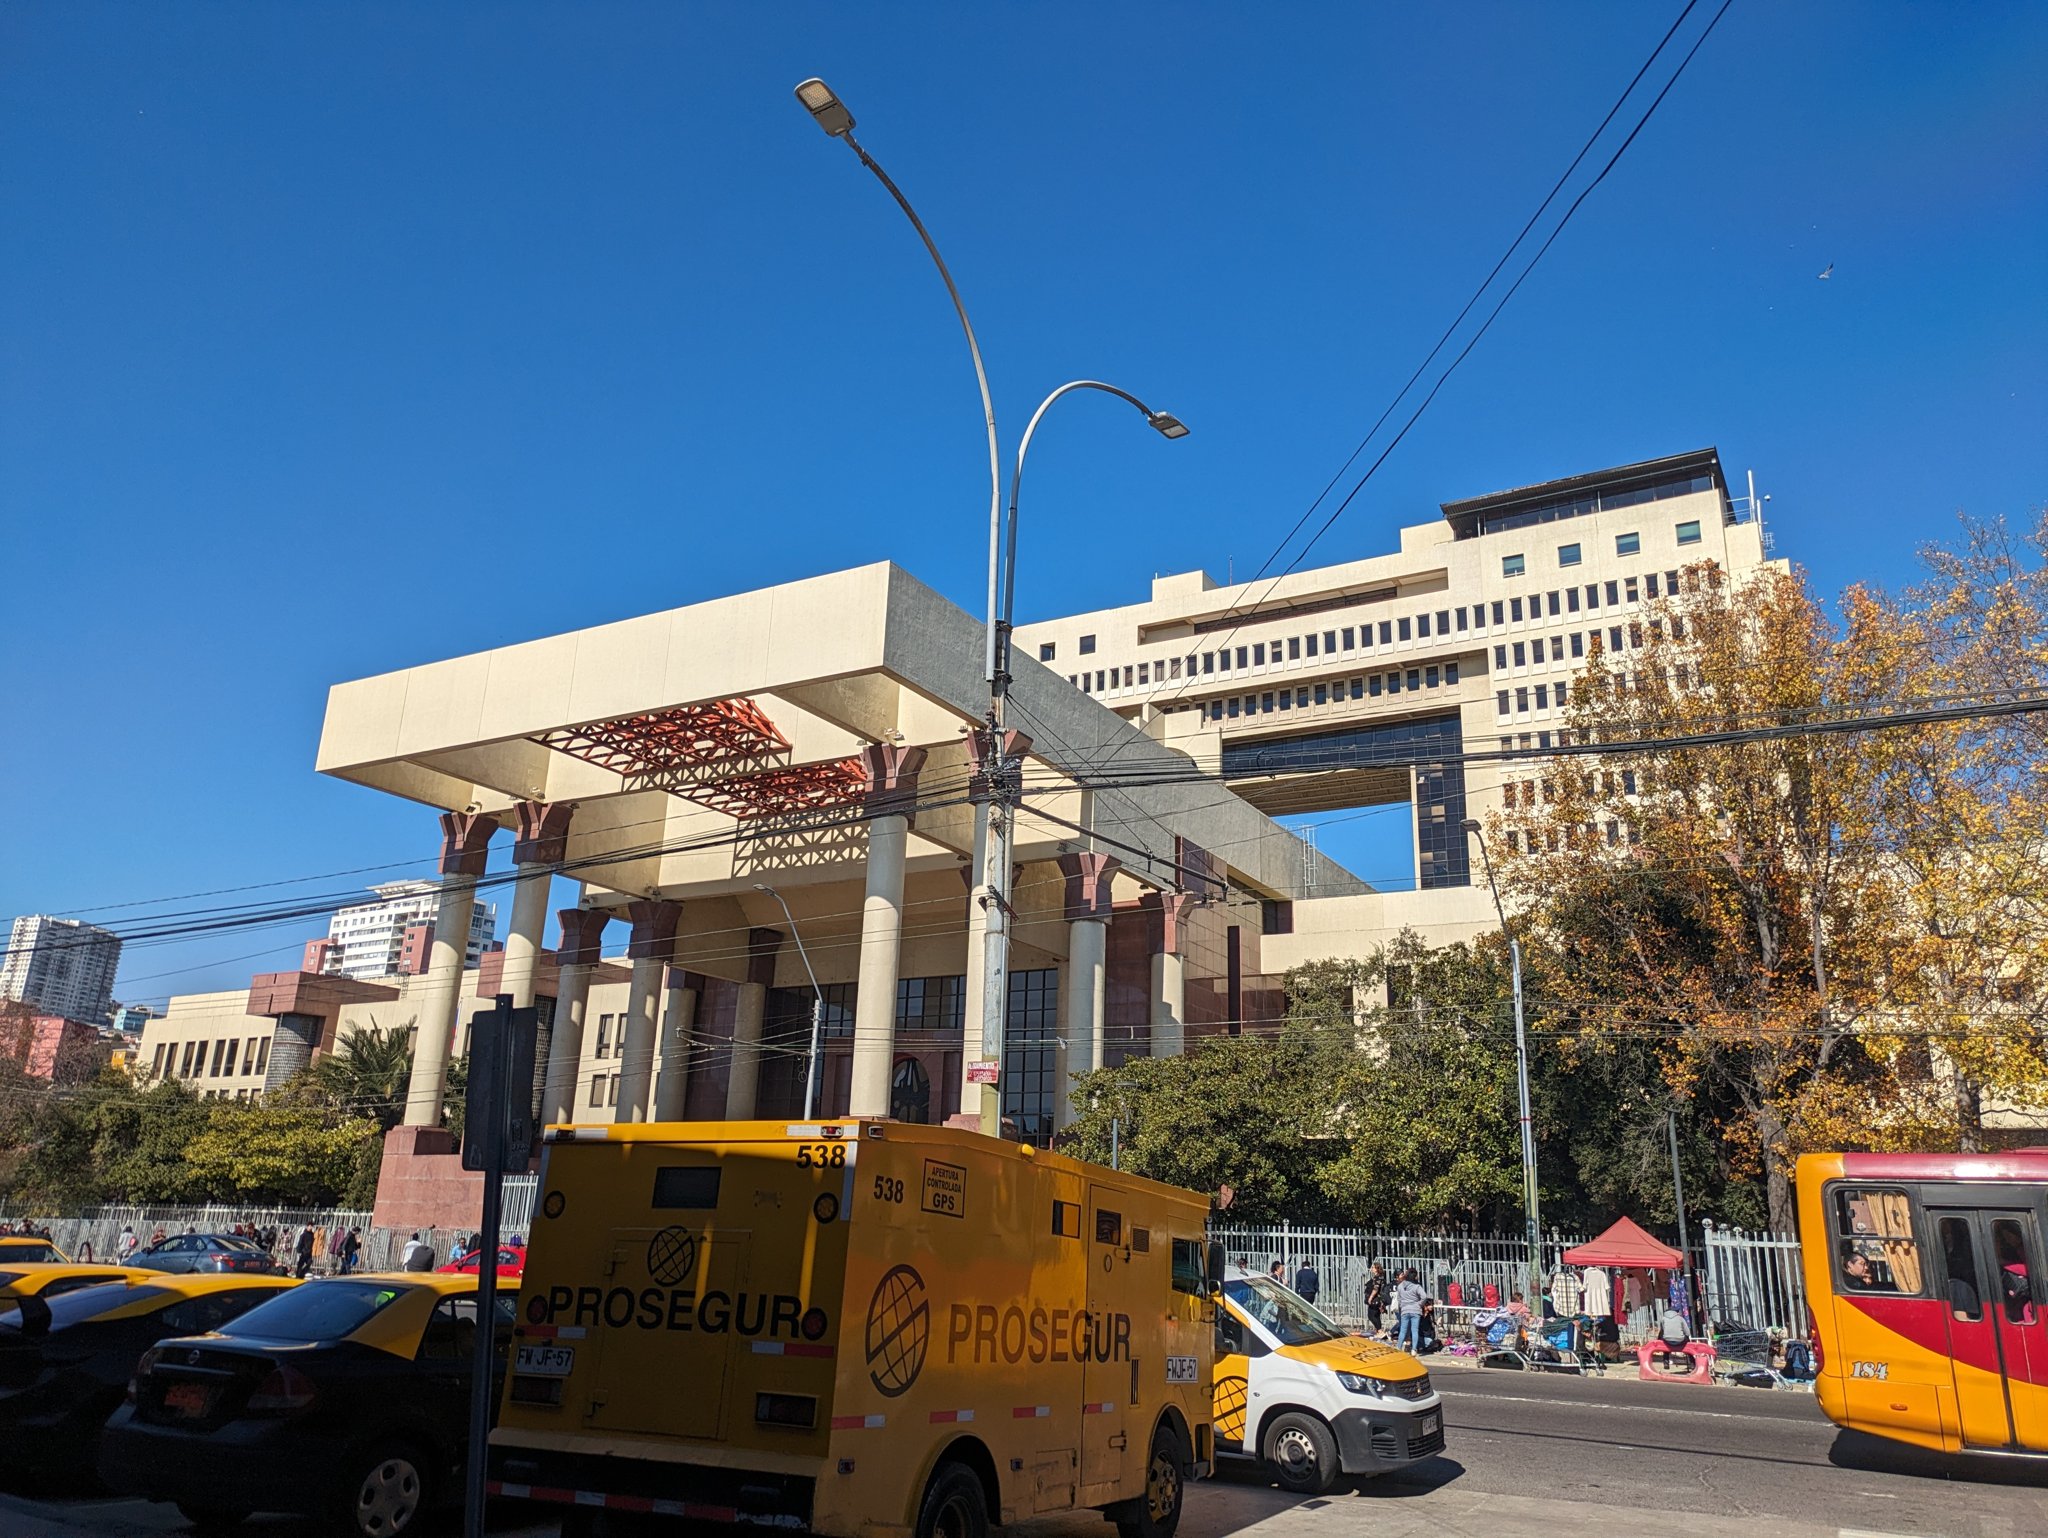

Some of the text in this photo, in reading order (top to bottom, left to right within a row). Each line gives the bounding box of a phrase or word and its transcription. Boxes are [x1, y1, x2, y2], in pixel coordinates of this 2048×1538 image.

[796, 1145, 846, 1169] 538
[932, 1166, 959, 1181] APERTURA
[873, 1175, 904, 1204] 538
[926, 1177, 962, 1193] CONTROLADA
[932, 1192, 955, 1211] GPS
[547, 1286, 803, 1339] PROSEGUR
[948, 1304, 1131, 1364] PROSEGUR
[1850, 1361, 1888, 1380] 184
